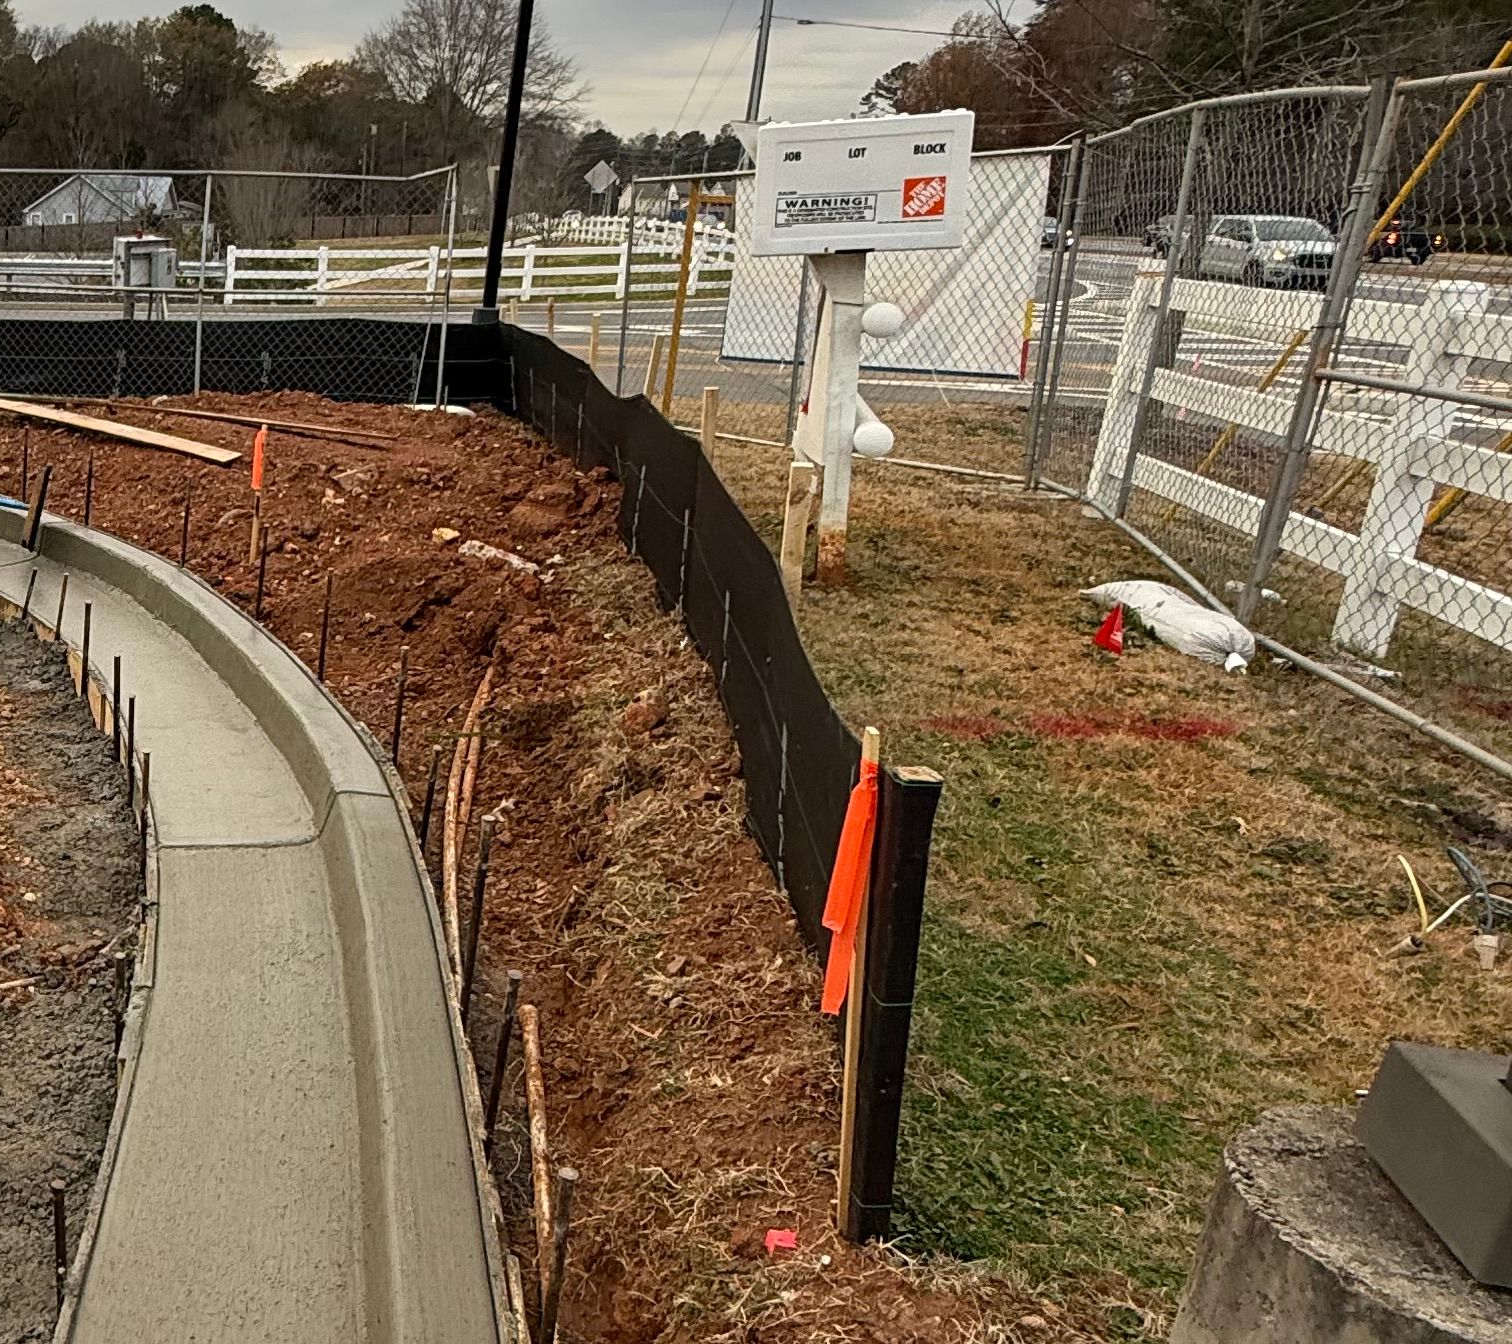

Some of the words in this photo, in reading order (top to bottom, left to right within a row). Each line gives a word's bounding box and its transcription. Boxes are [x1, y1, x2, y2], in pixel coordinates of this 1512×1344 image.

[783, 151, 801, 162] JOB
[848, 147, 867, 158] LOT
[913, 143, 947, 155] BLOCK
[904, 177, 945, 216] HOME
[909, 181, 926, 197] THE
[785, 197, 869, 208] WARNING!
